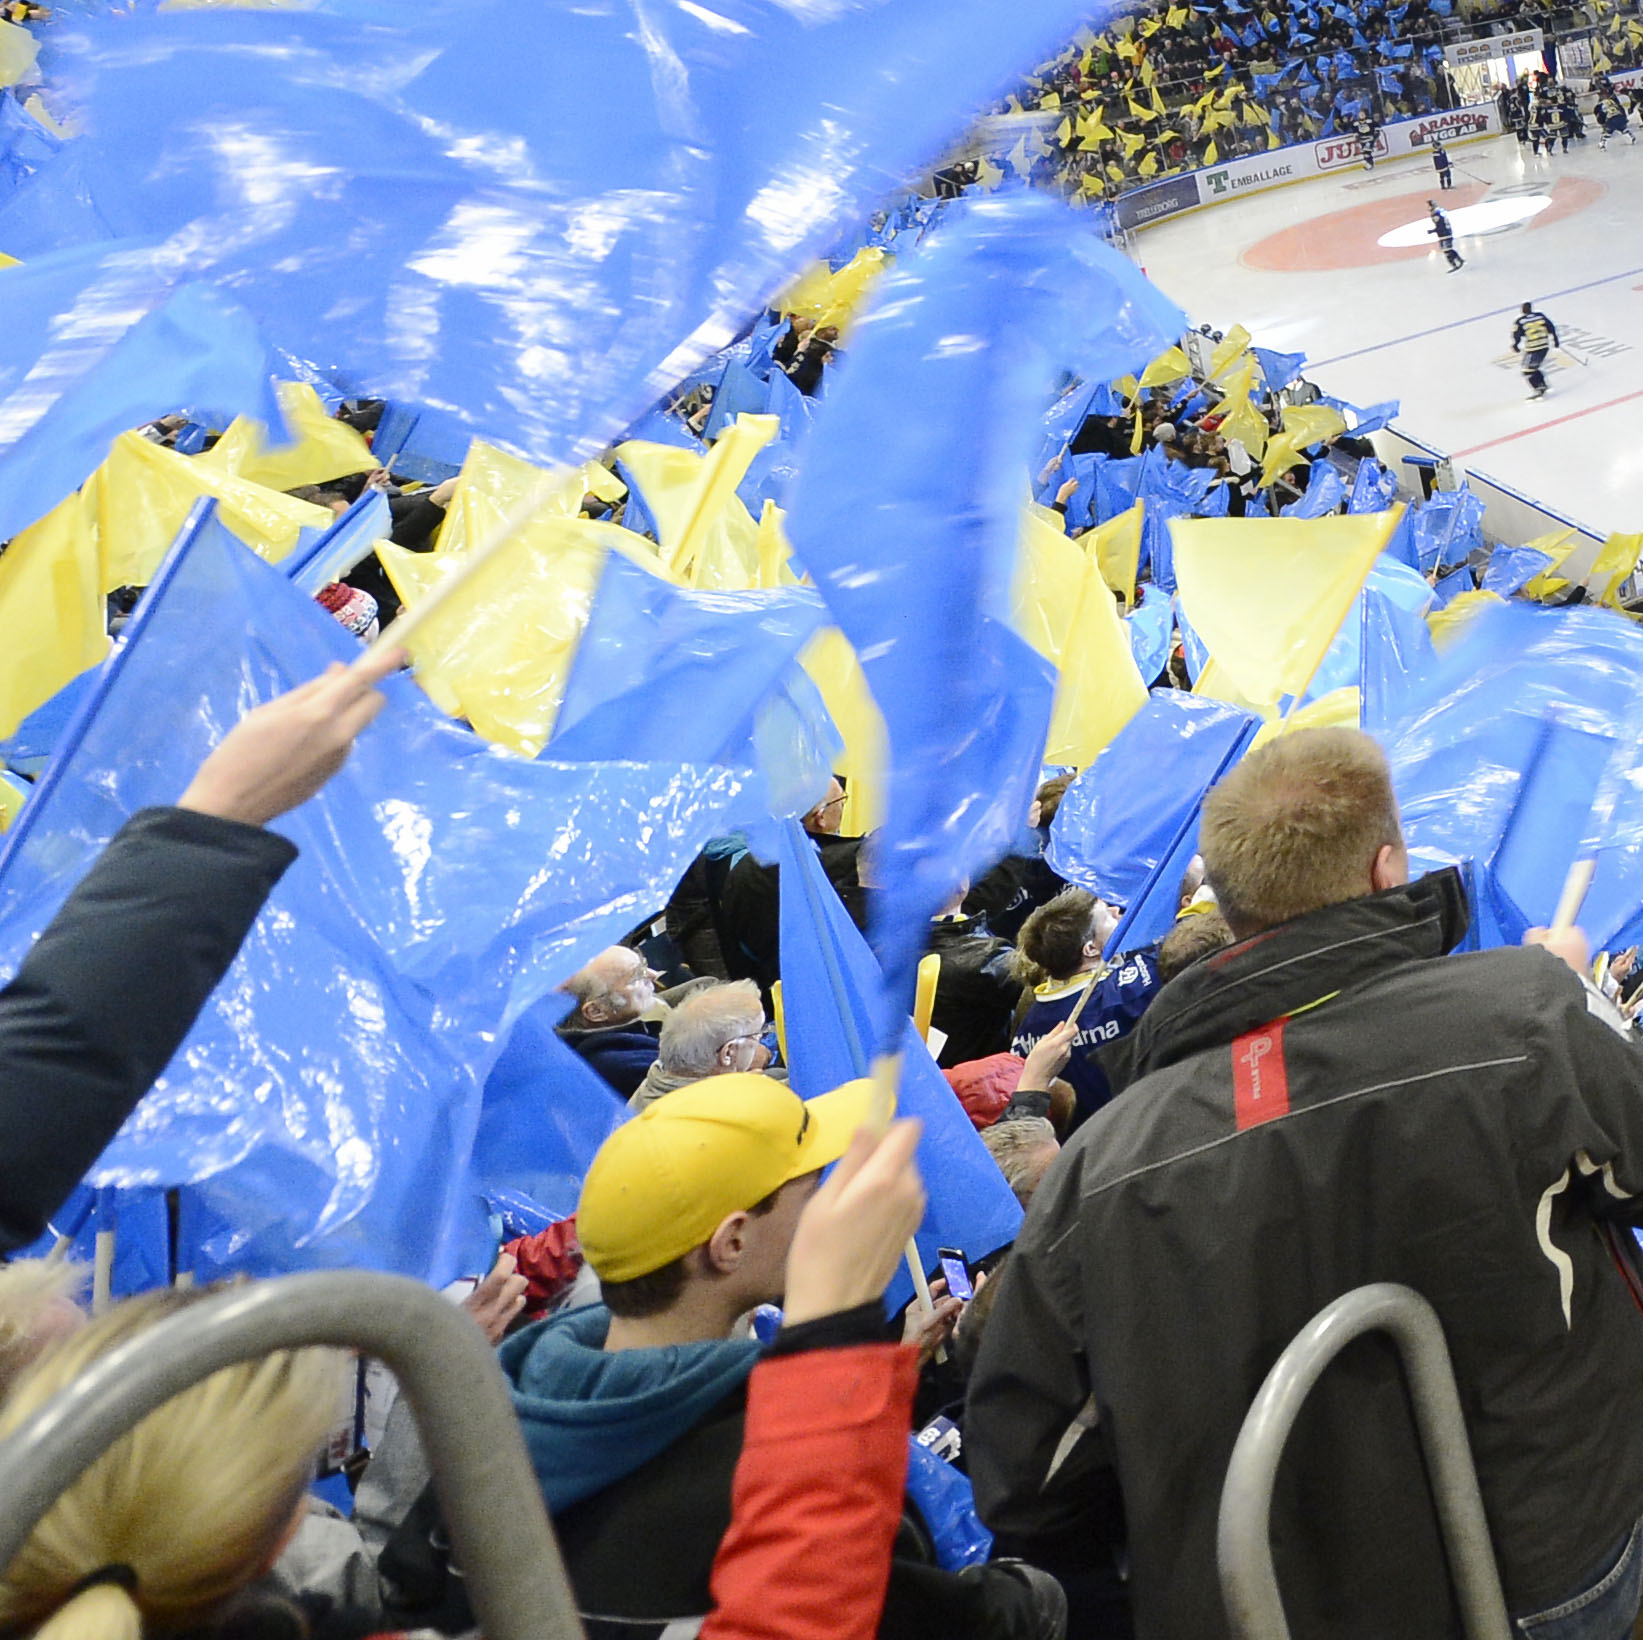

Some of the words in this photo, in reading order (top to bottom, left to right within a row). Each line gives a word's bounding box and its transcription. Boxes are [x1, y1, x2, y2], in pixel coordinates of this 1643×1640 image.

[1423, 128, 1458, 143] BYGG
[1460, 123, 1477, 135] AB
[1230, 164, 1293, 190] EMBALLAGE
